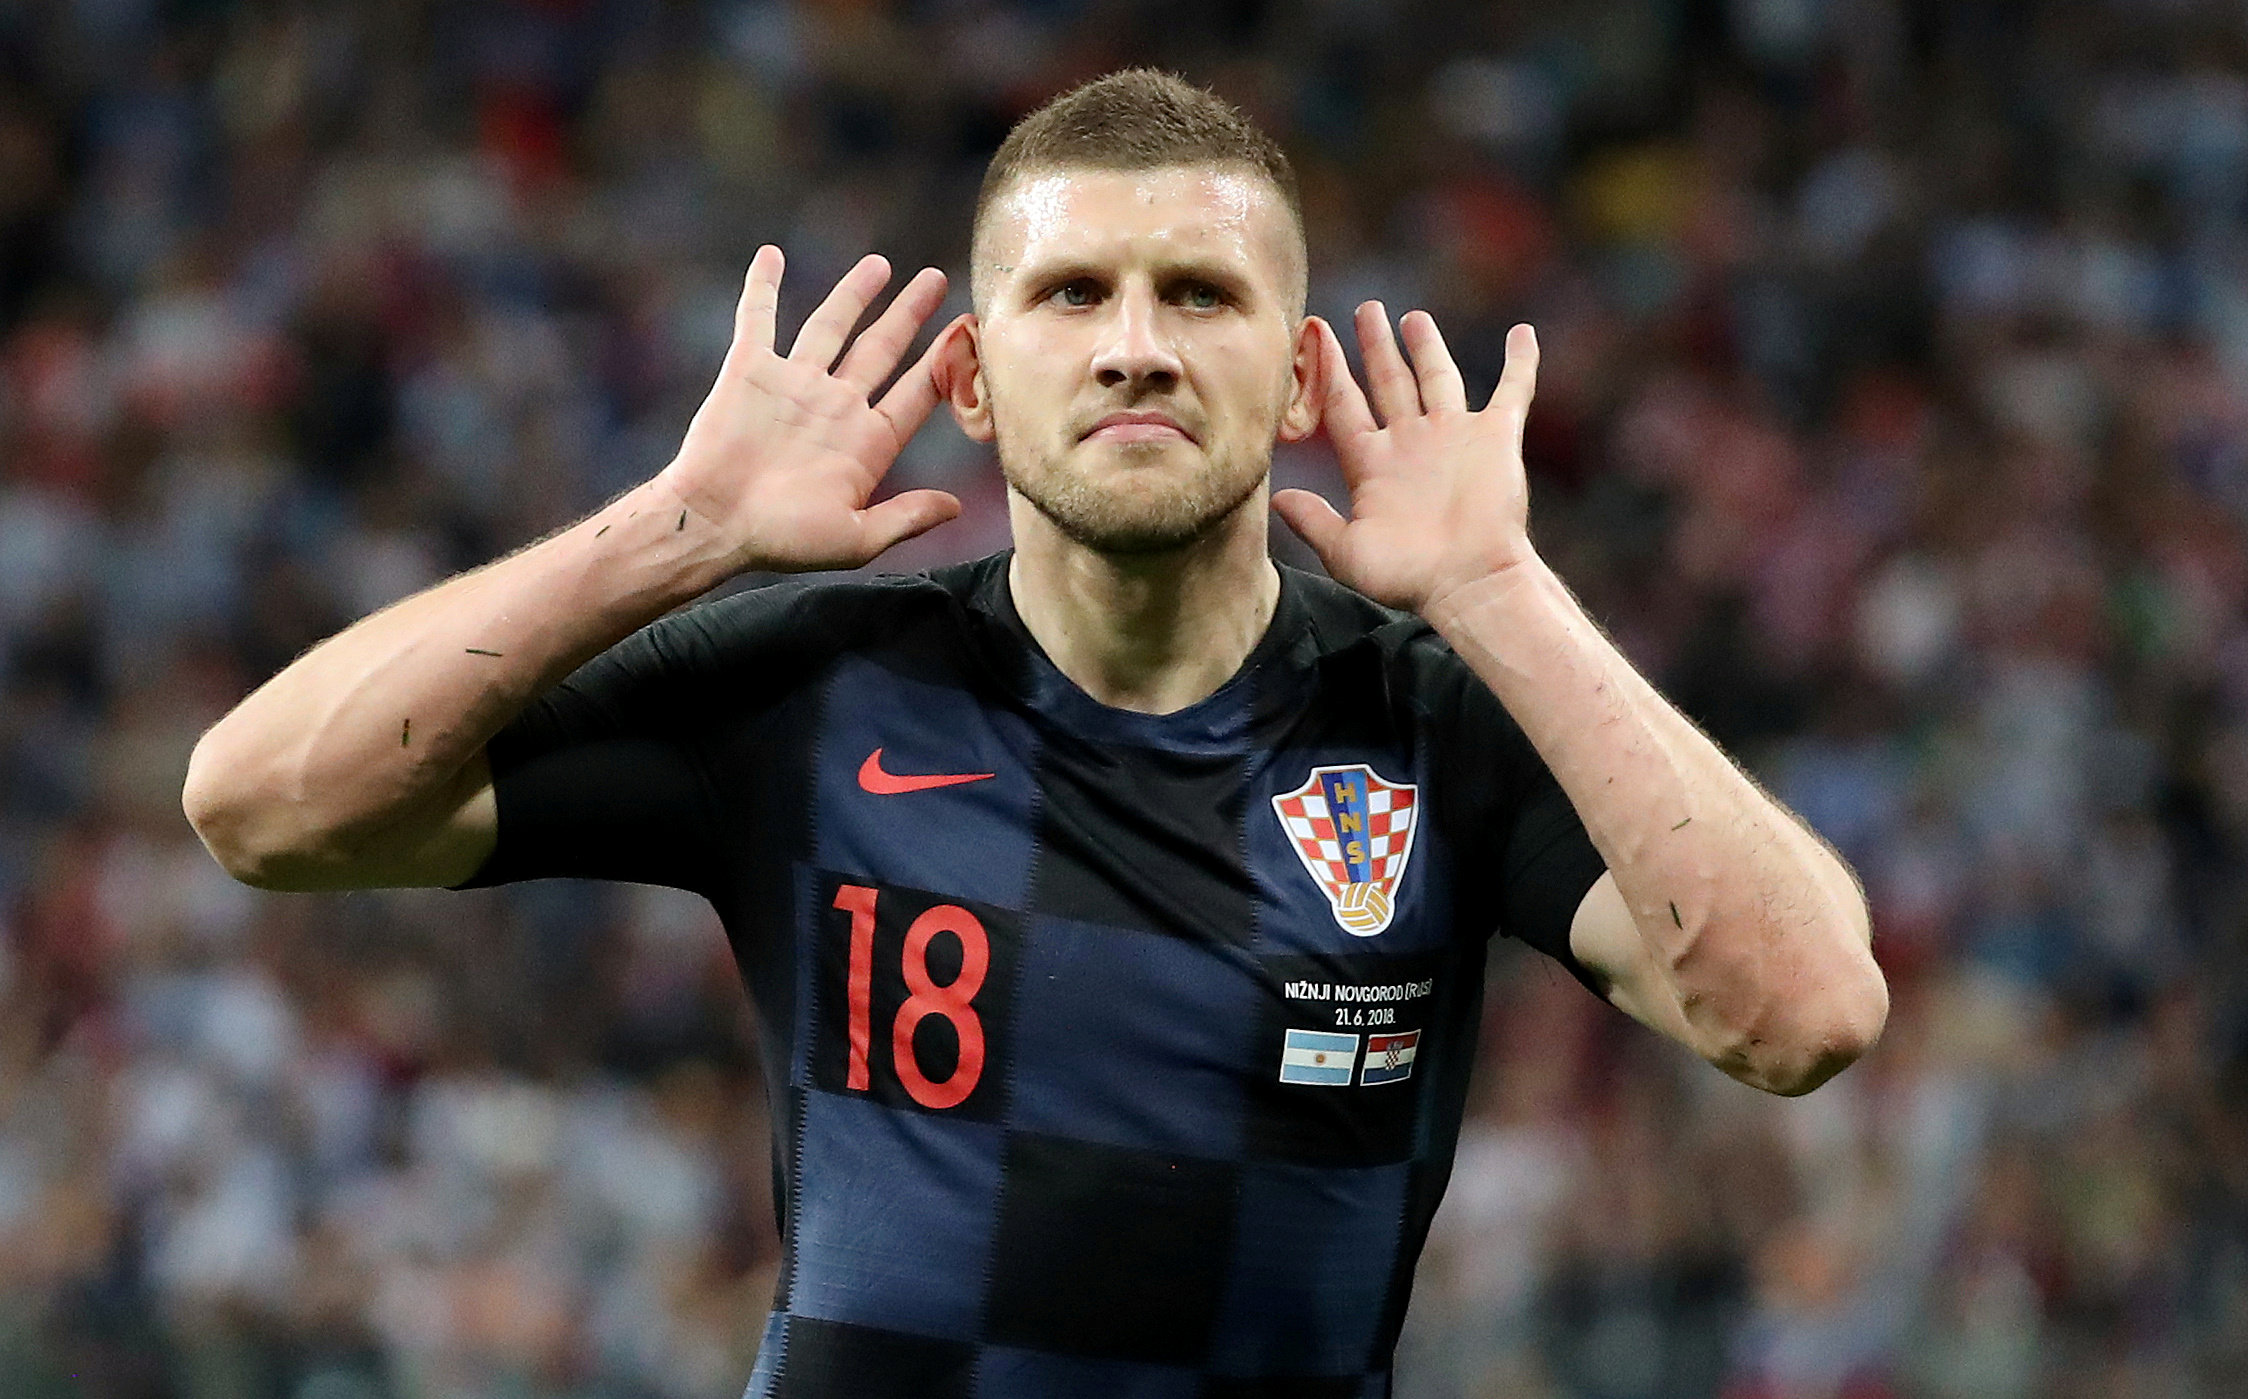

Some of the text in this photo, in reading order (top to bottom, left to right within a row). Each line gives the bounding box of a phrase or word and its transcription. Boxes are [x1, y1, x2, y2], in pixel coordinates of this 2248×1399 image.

[1334, 782, 1366, 864] HNS
[832, 884, 991, 1109] 18
[1285, 980, 1331, 1001] NIŽNJI
[1334, 984, 1404, 1002] NOVGOROD
